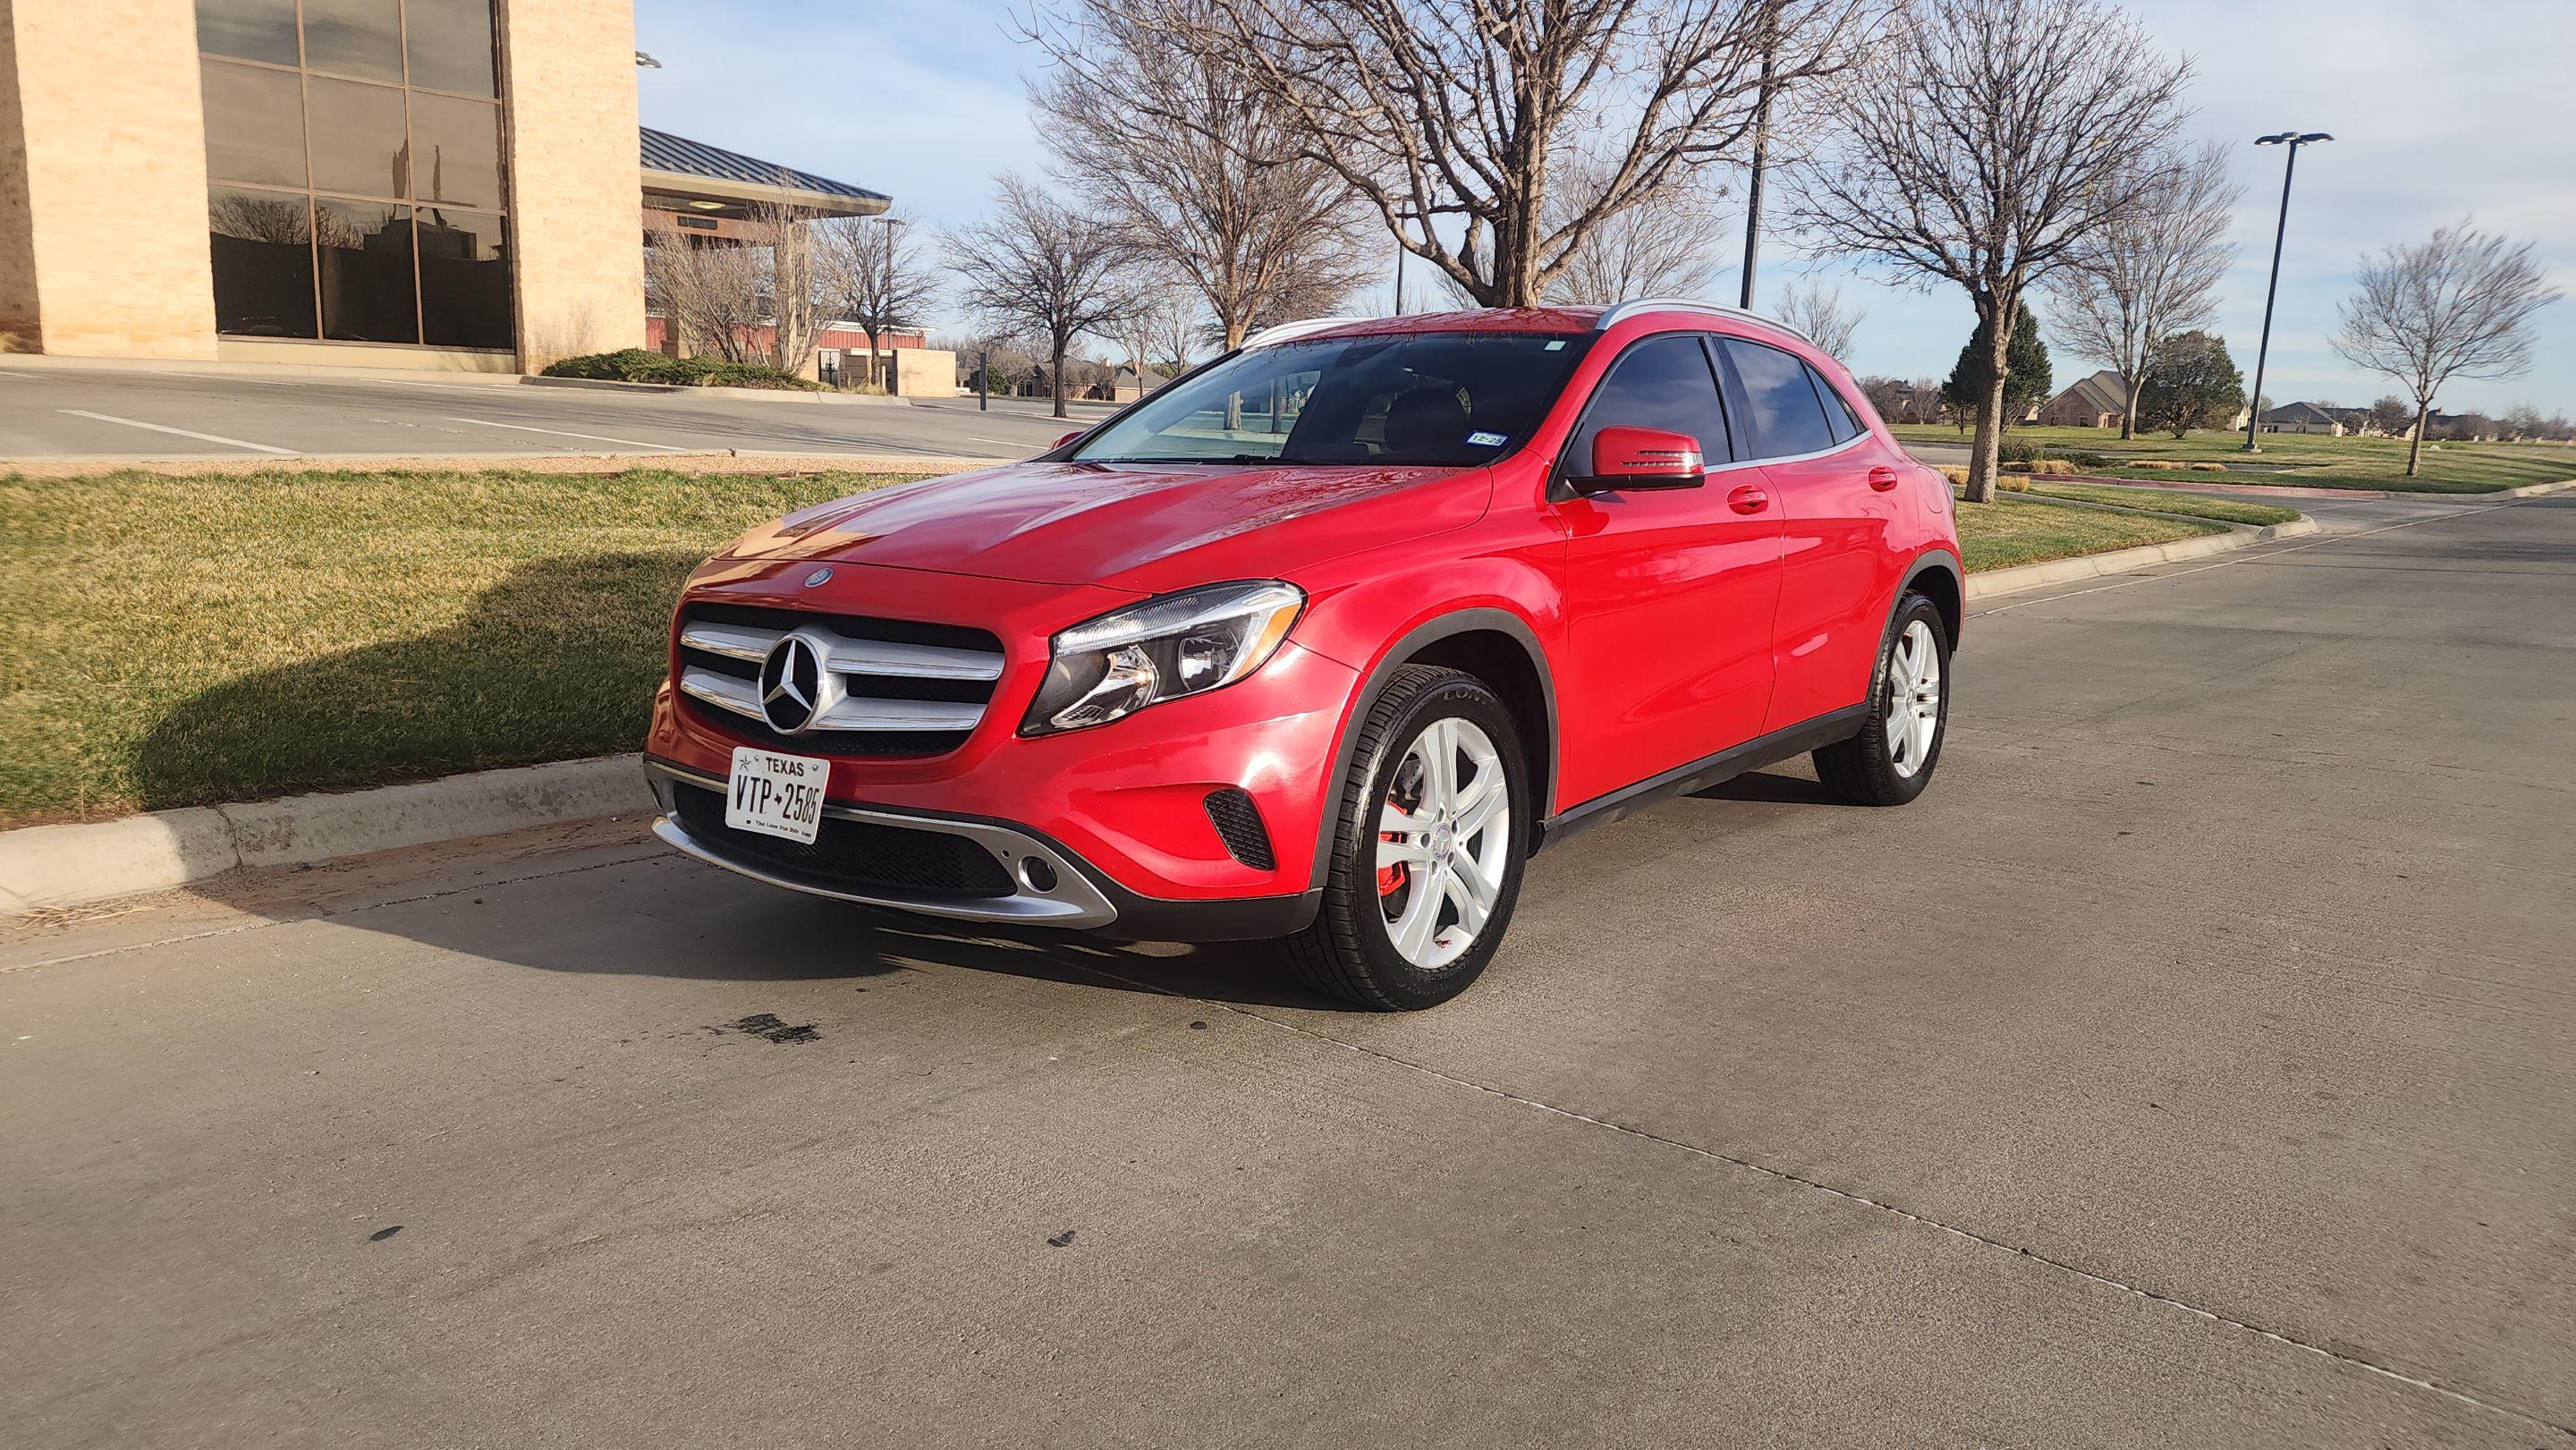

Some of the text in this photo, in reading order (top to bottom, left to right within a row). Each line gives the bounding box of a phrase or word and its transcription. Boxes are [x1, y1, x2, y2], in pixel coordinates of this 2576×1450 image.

[766, 757, 805, 777] TEXAS
[736, 774, 820, 825] VTP 2585
